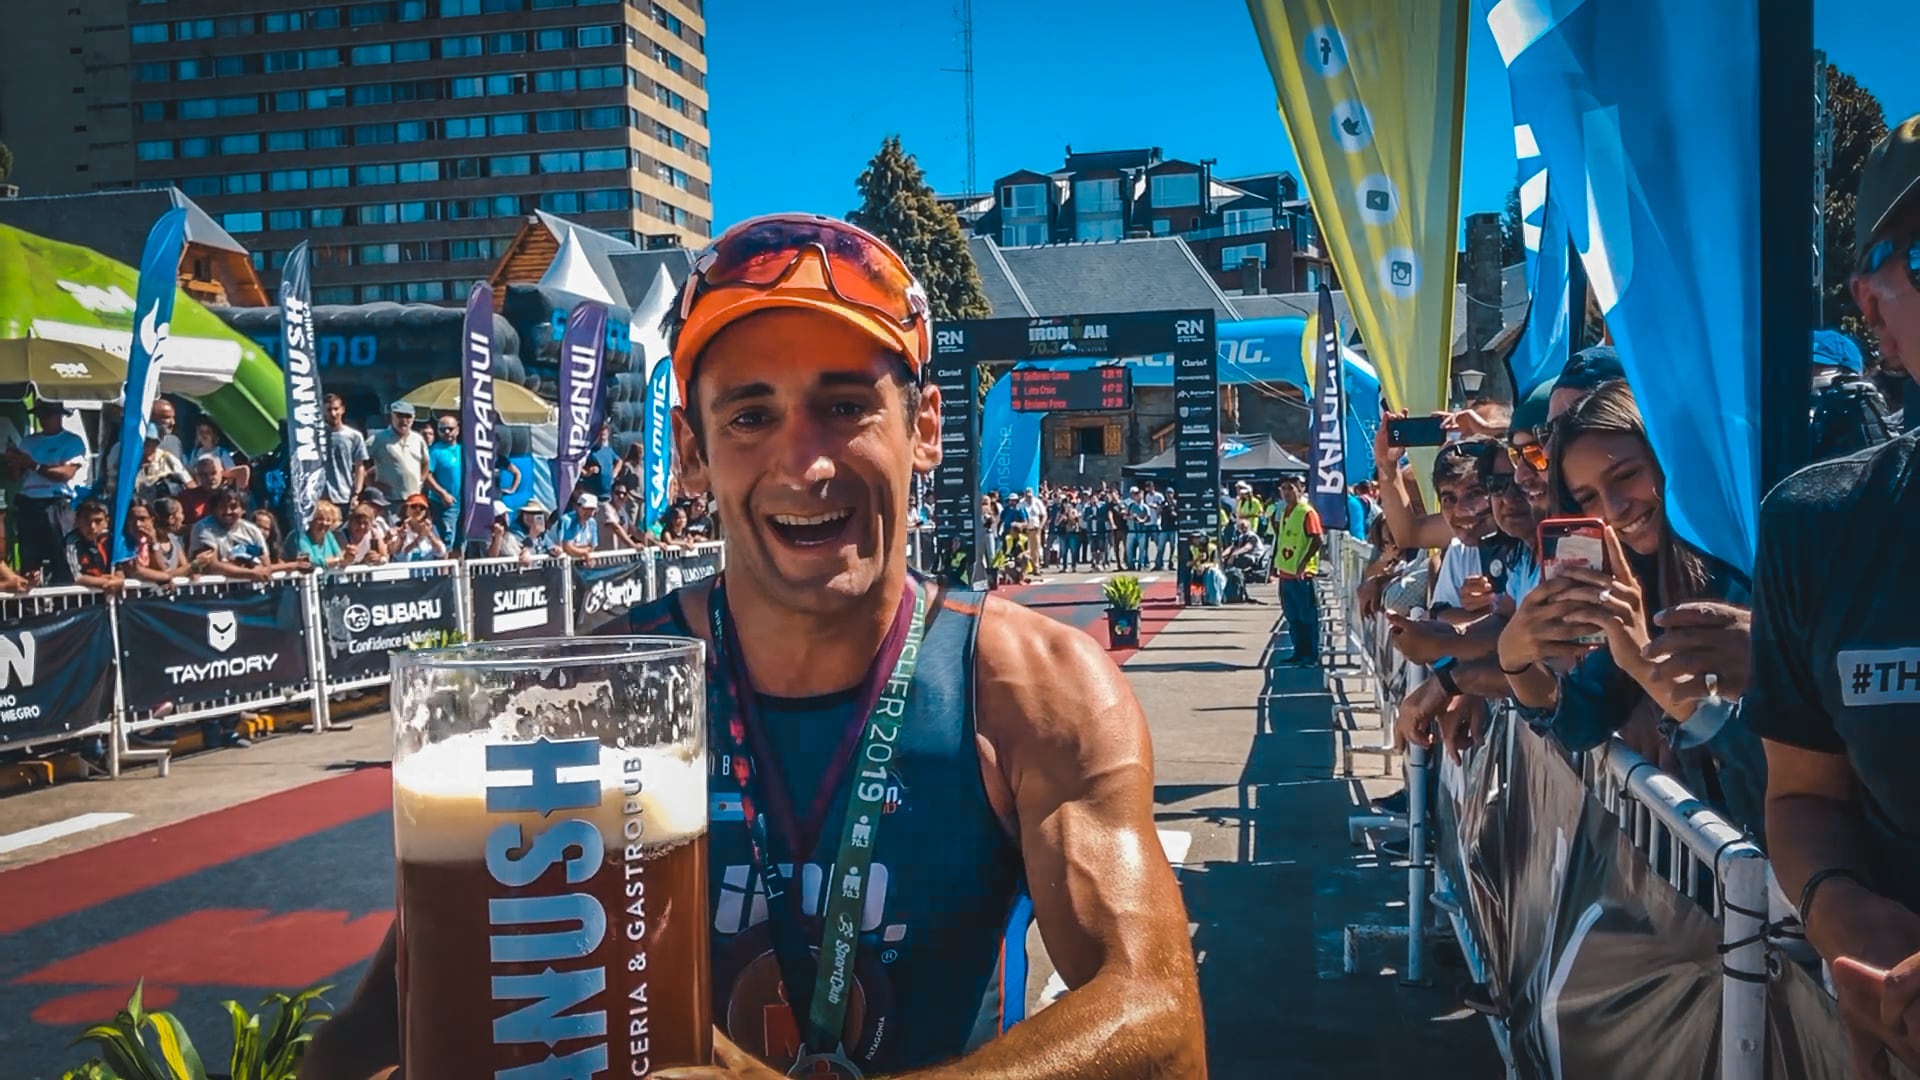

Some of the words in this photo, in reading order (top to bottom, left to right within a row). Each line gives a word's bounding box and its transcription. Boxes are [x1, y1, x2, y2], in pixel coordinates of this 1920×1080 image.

[286, 296, 319, 461] MANUSH
[470, 332, 494, 505] RAPANUI
[372, 598, 441, 627] SUBARU
[349, 635, 401, 654] Confidence
[165, 653, 279, 685] TAYMORY
[1852, 660, 1920, 695] #TH
[857, 724, 898, 803] 2019
[623, 757, 647, 941] GASTROPUB
[627, 952, 648, 971] &
[629, 982, 650, 1077] CERIA
[866, 1015, 886, 1061] PATAGONIA
